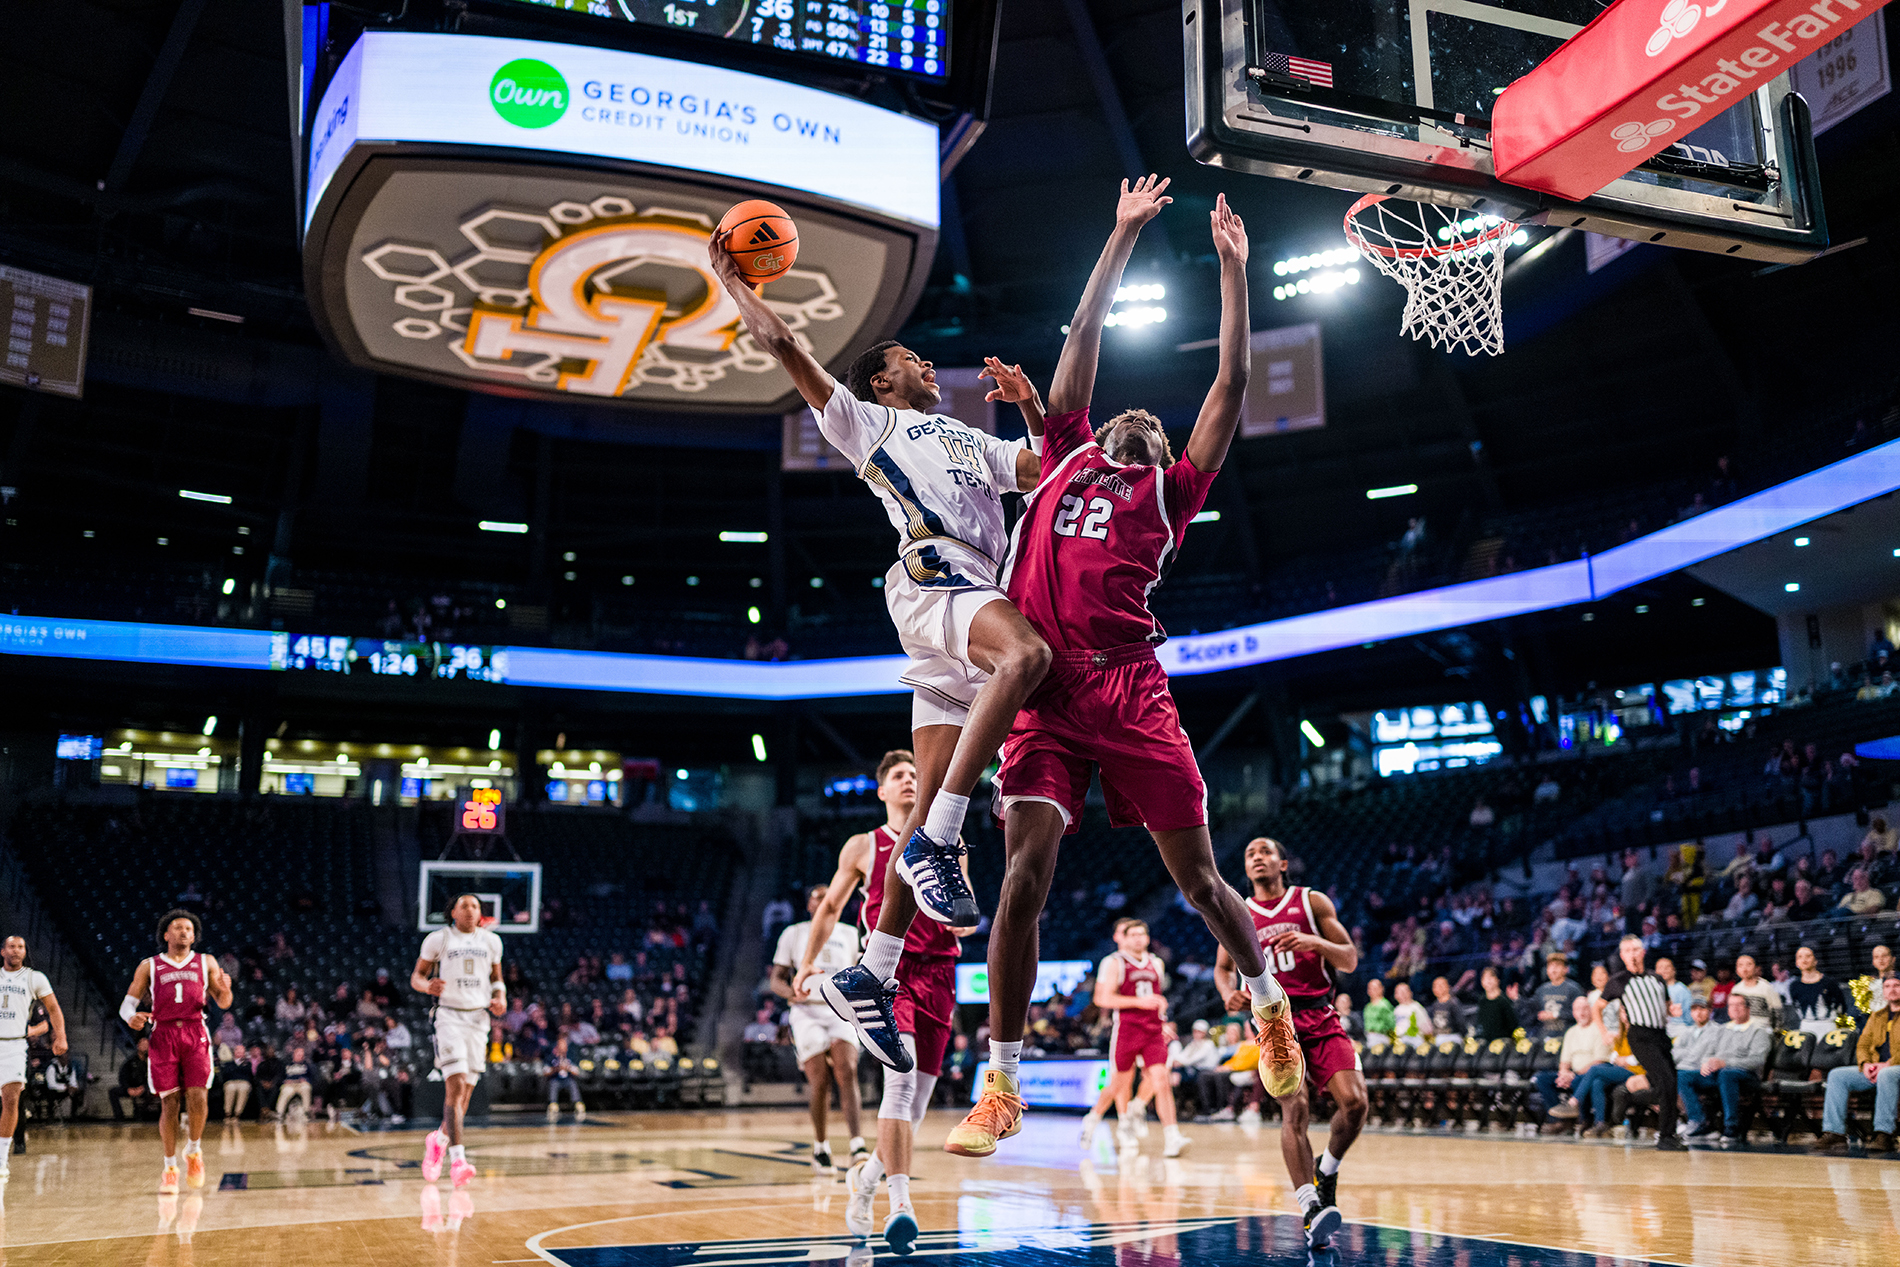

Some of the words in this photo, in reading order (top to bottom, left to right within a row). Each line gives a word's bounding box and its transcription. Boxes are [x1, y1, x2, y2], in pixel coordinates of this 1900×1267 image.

[663, 3, 699, 28] 1ST
[755, 0, 795, 21] 36
[869, 3, 890, 19] 10
[902, 8, 915, 24] 5
[925, 14, 939, 28] 0
[750, 16, 765, 33] 7
[778, 22, 792, 38] 3
[900, 24, 915, 39] 0
[926, 29, 937, 43] 1
[868, 33, 888, 50] 21
[900, 39, 914, 54] 9
[924, 43, 938, 59] 2
[866, 48, 890, 66] 22
[899, 54, 914, 70] 9
[923, 58, 938, 75] 0
[1818, 47, 1858, 90] 1996
[493, 78, 566, 110] Own
[583, 79, 758, 126] GEORGIA'S
[772, 112, 842, 146] OWN
[581, 105, 665, 132] CREDIT
[676, 119, 750, 146] UNION
[938, 435, 983, 475] 14
[1053, 493, 1115, 542] 22
[293, 635, 327, 659] 45
[450, 646, 483, 669] 36
[368, 652, 418, 676] 1:24
[462, 801, 497, 829] 26
[174, 982, 183, 1004] 1
